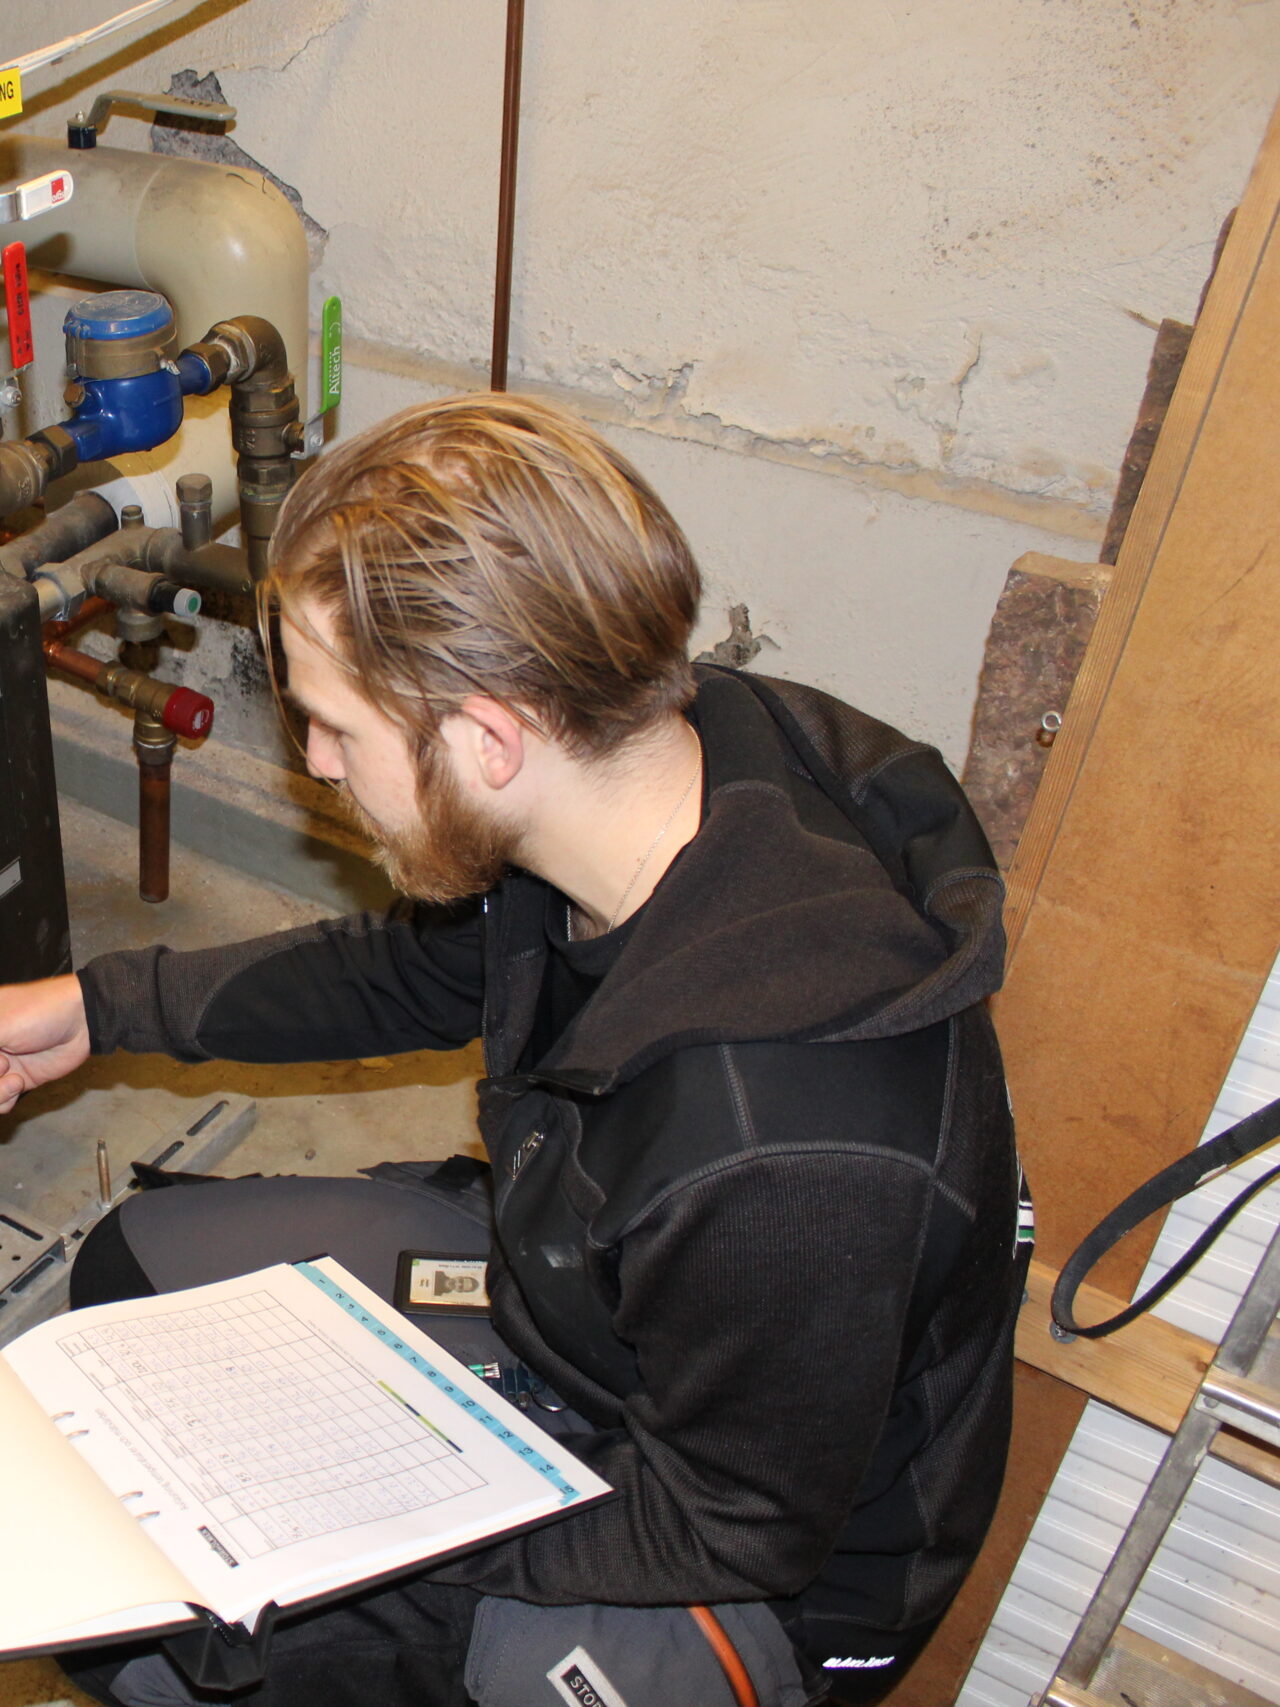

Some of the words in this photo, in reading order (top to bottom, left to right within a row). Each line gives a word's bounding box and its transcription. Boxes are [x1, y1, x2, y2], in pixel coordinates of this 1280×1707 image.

[329, 346, 340, 394] Altech
[461, 1400, 476, 1409] 10
[478, 1415, 493, 1424] 11
[497, 1430, 513, 1440] 12
[517, 1446, 534, 1456] 13
[539, 1464, 555, 1474] 14
[558, 1485, 575, 1496] 15
